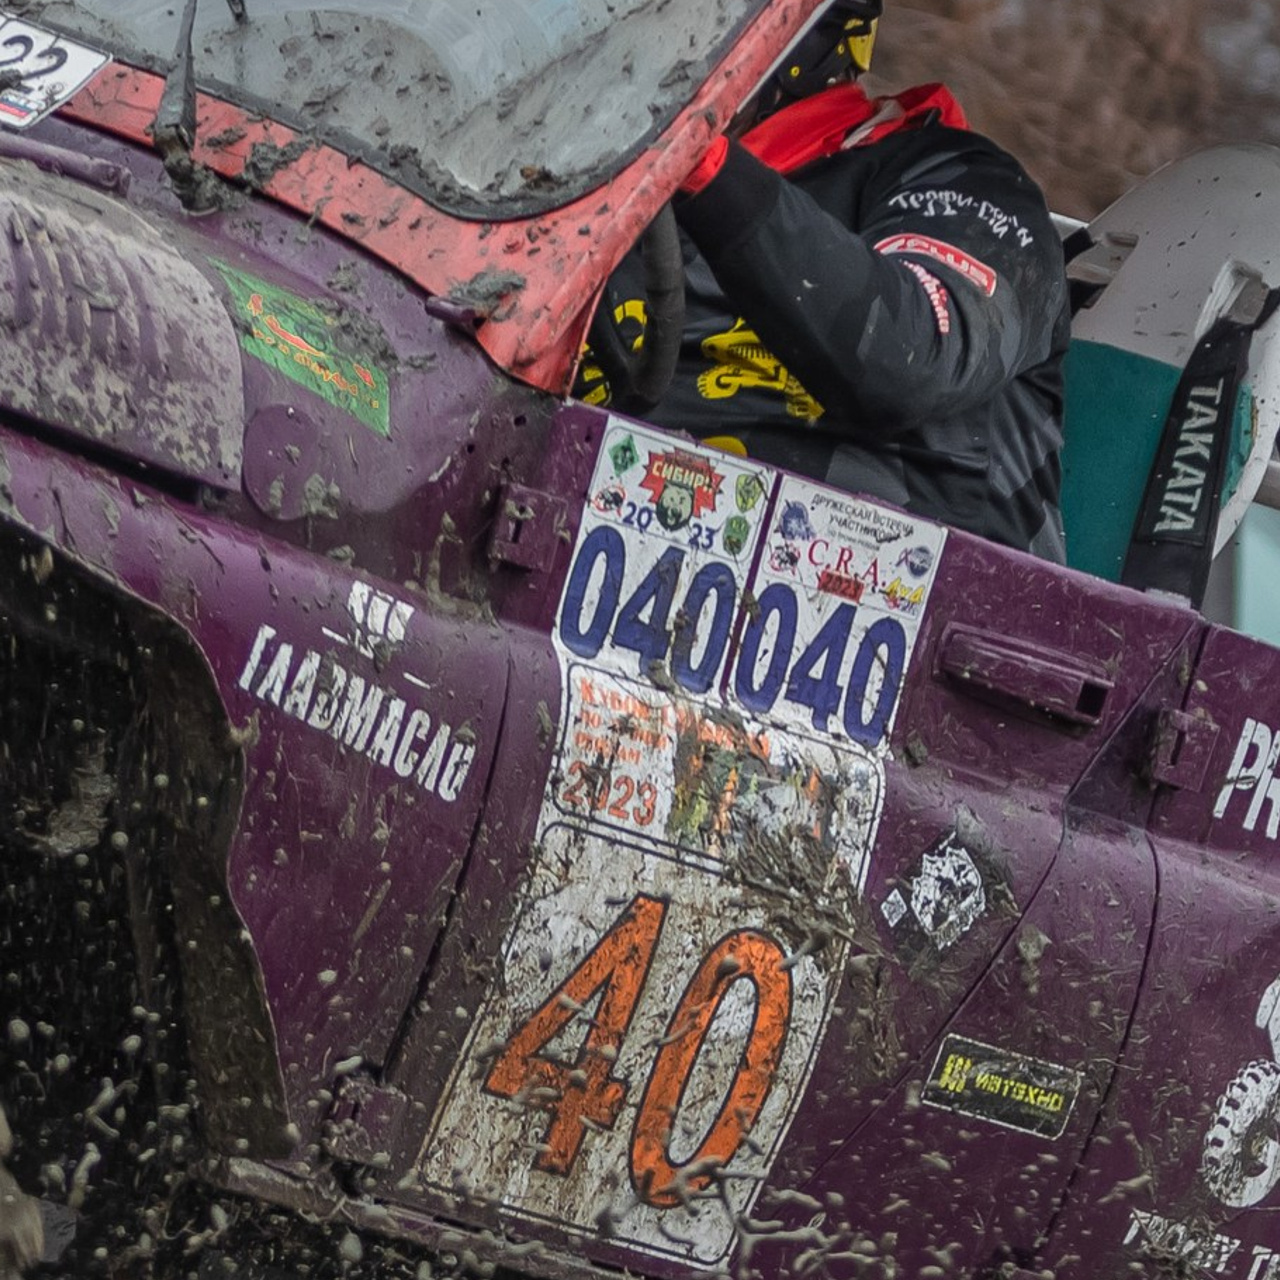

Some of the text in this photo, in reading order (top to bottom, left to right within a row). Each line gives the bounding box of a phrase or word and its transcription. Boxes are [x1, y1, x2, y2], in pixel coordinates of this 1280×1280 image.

[623, 502, 716, 550] 20 23
[1153, 377, 1225, 534] TAKATA
[559, 524, 738, 695] 040
[734, 582, 907, 748] 040
[485, 891, 794, 1209] 40
